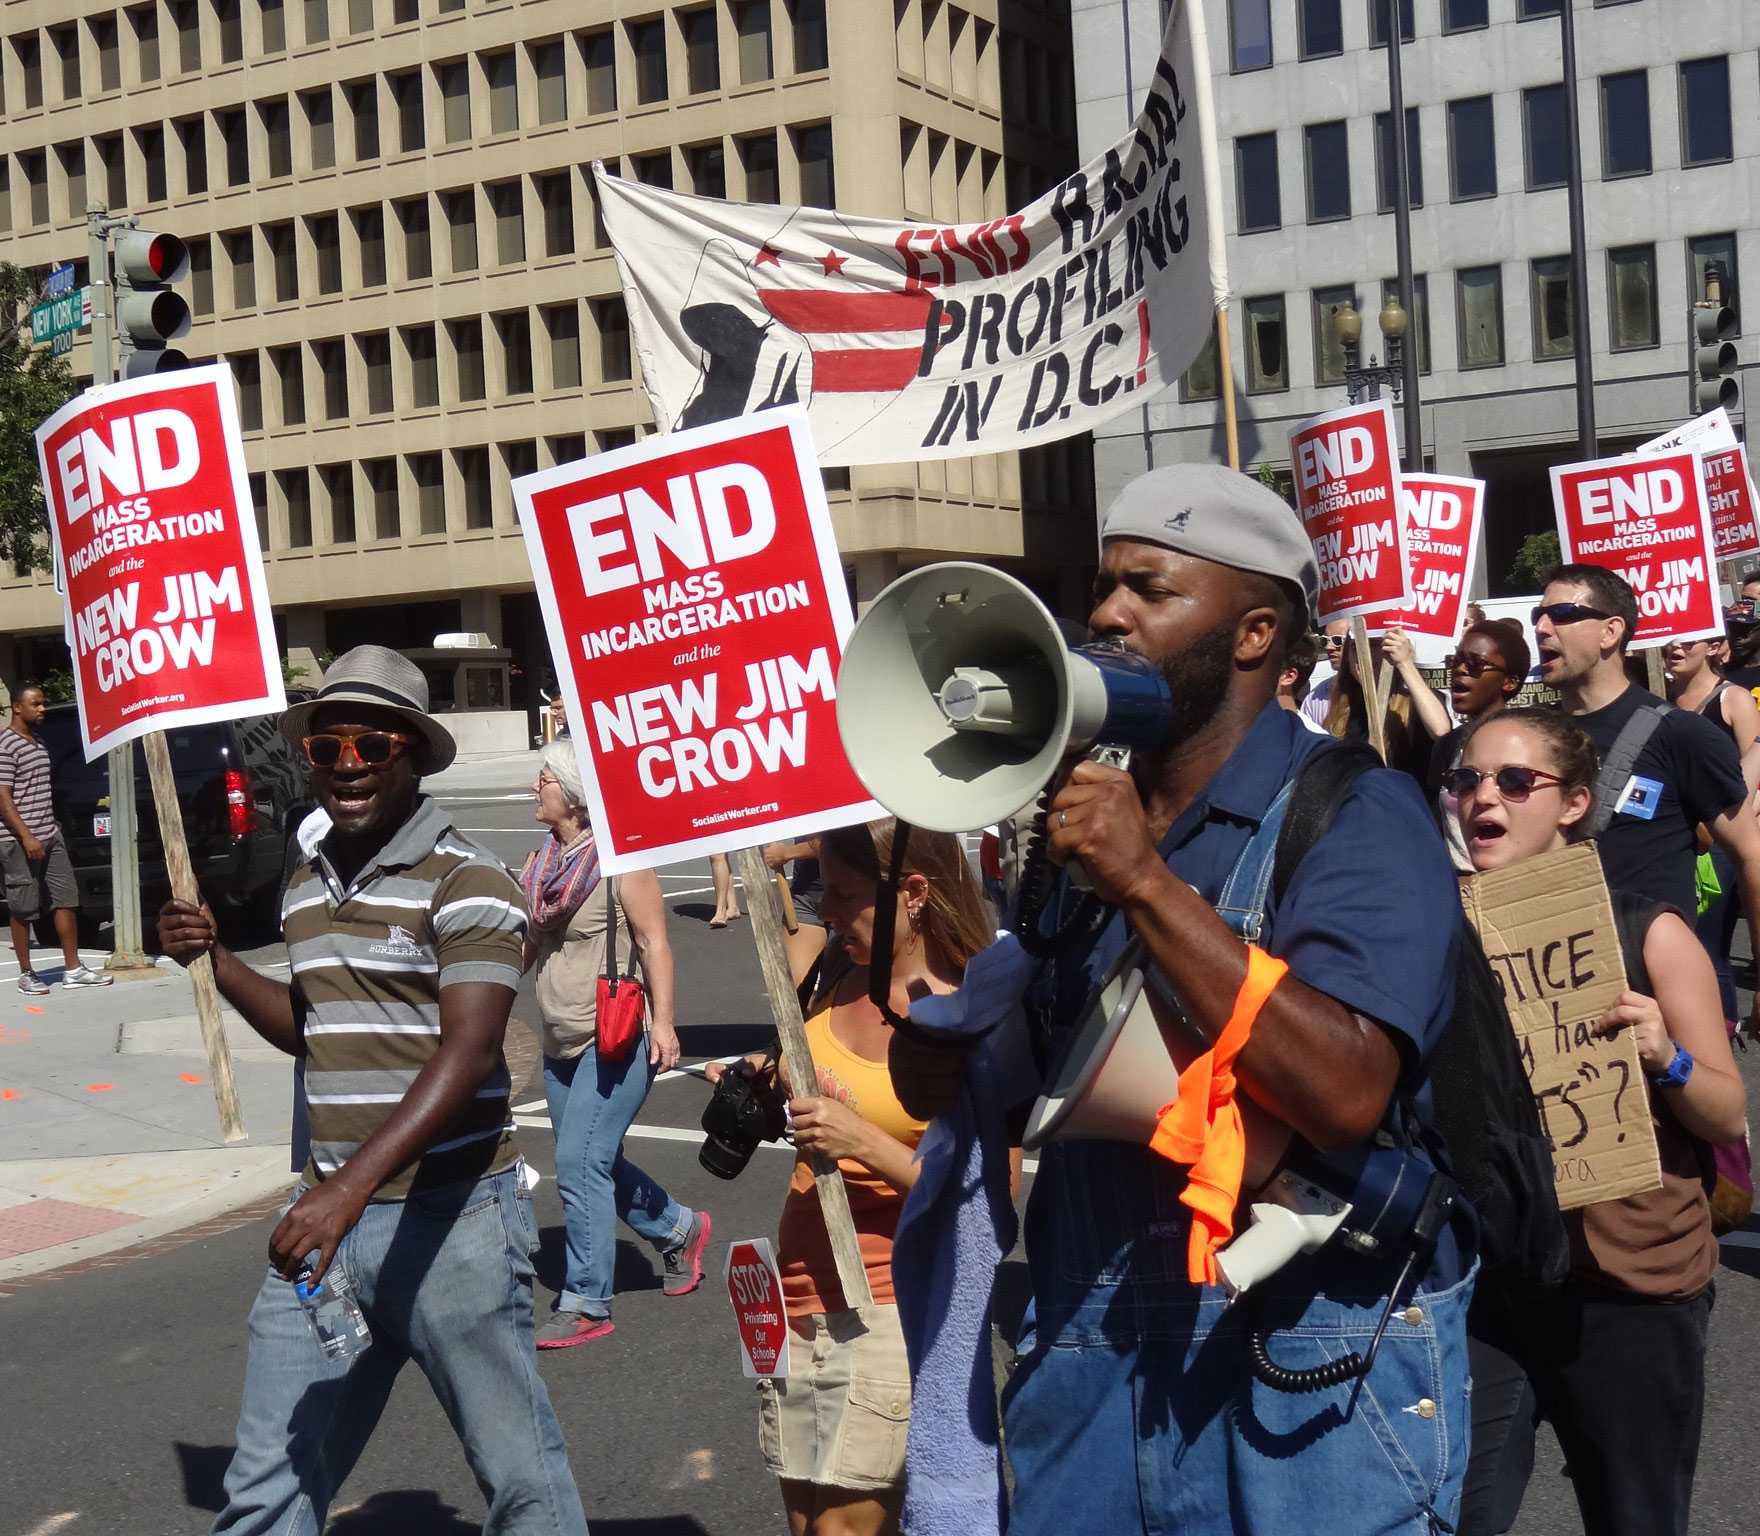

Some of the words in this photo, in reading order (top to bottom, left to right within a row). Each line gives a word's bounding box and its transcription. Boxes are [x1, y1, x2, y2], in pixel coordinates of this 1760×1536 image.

[895, 215, 1030, 291] END
[918, 158, 1190, 377] PROFILING
[33, 307, 50, 338] NEW
[52, 298, 73, 330] YORK
[921, 374, 1003, 447] IN
[1016, 299, 1151, 431] D.C.!
[57, 408, 200, 525] END
[1298, 426, 1375, 490] END
[1702, 456, 1735, 480] ITE
[1318, 480, 1348, 500] MASS
[1577, 468, 1684, 526] END
[1709, 489, 1740, 512] GHT
[92, 497, 152, 534] MASS
[1402, 489, 1462, 530] ND
[1613, 518, 1657, 536] MASS
[69, 509, 224, 578] INCARCERATION
[565, 462, 777, 598] END
[1347, 519, 1394, 555] JIM
[1407, 528, 1430, 541] ASS
[1578, 525, 1697, 555] INCARCERATION
[1714, 522, 1756, 547] CISM
[1408, 540, 1462, 557] ERATION
[1626, 552, 1640, 561] and
[1641, 551, 1652, 559] the
[108, 559, 124, 577] and
[125, 557, 145, 571] the
[1319, 550, 1380, 590] CROW
[1415, 568, 1461, 596] JIM
[1655, 556, 1704, 588] JIM
[642, 571, 725, 615] MASS
[1634, 584, 1690, 618] OW
[76, 581, 140, 656] NEW
[153, 566, 243, 624] JIM
[580, 580, 810, 661] INCARCERATION
[95, 618, 217, 693] CROW
[673, 647, 698, 667] and
[700, 643, 721, 660] the
[592, 672, 718, 753] NEW
[735, 646, 837, 721] JIM
[1424, 678, 1452, 689] VIOLE
[121, 693, 185, 717] SocialistWorker.org
[636, 711, 809, 799] CROW
[692, 801, 779, 829] SocialistWorker.org
[368, 944, 424, 956] BURBERRY
[1488, 930, 1596, 1001] TICE
[732, 1264, 770, 1304] STOP
[744, 1310, 778, 1326] Privatizing
[755, 1329, 766, 1342] Our
[752, 1346, 775, 1359] Schools
